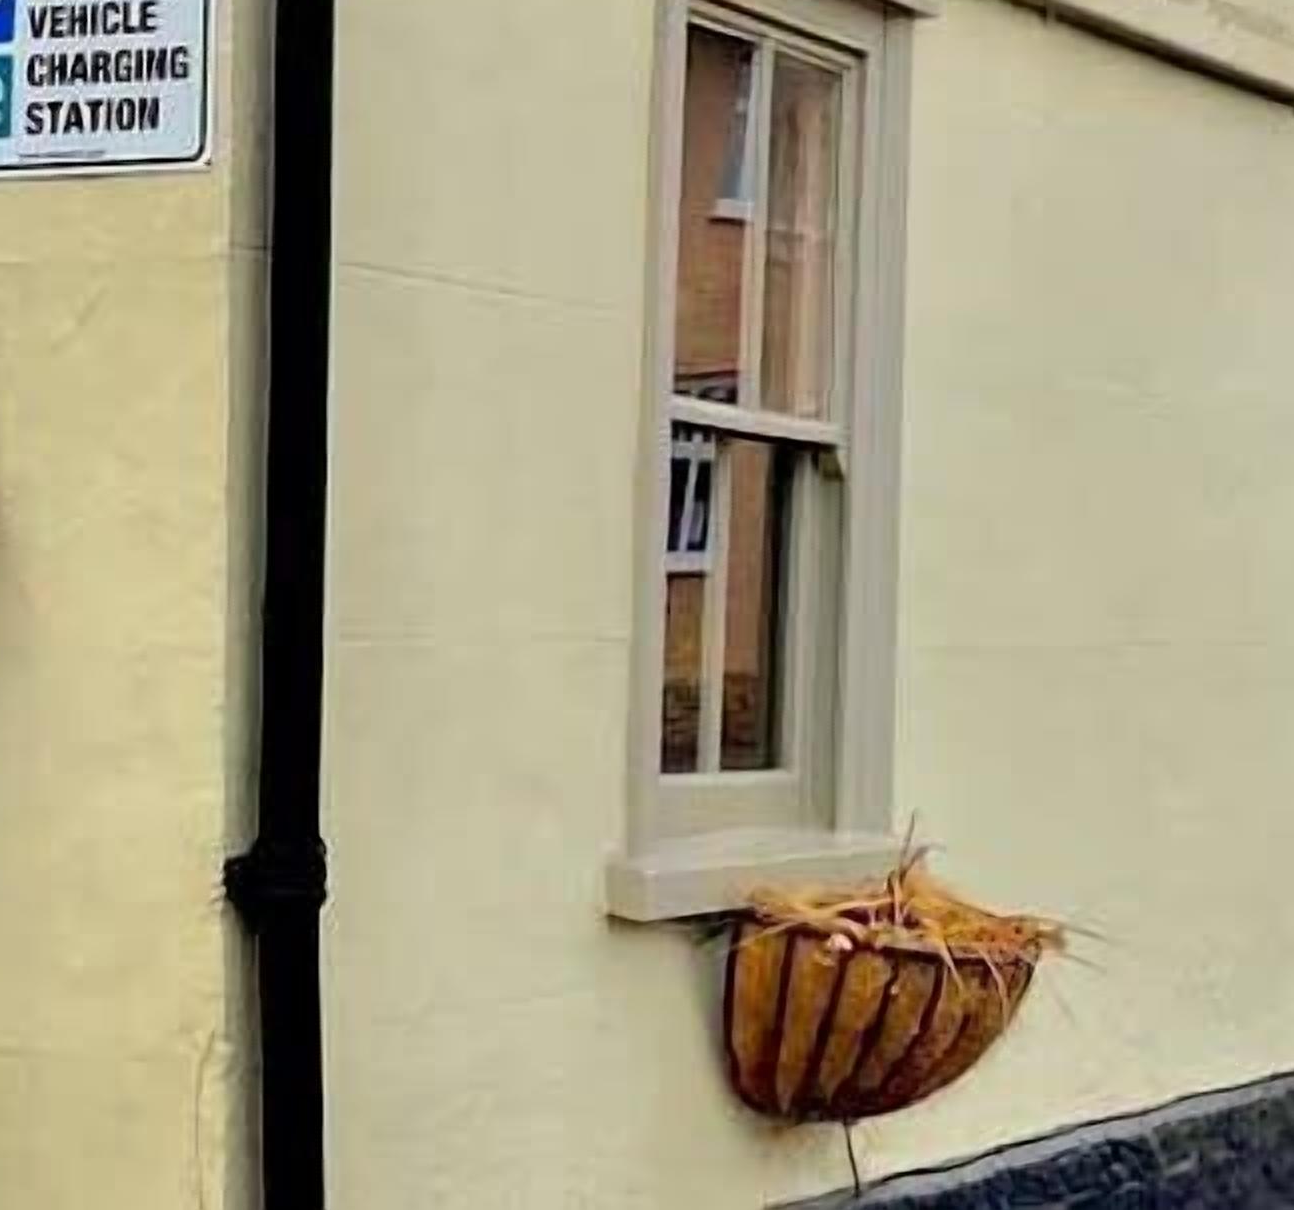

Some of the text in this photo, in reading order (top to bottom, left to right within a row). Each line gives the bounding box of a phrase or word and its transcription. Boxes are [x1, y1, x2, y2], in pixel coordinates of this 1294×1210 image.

[27, 0, 159, 41] VEHICLE
[26, 45, 191, 88] CHARGING
[25, 96, 161, 137] STATION
